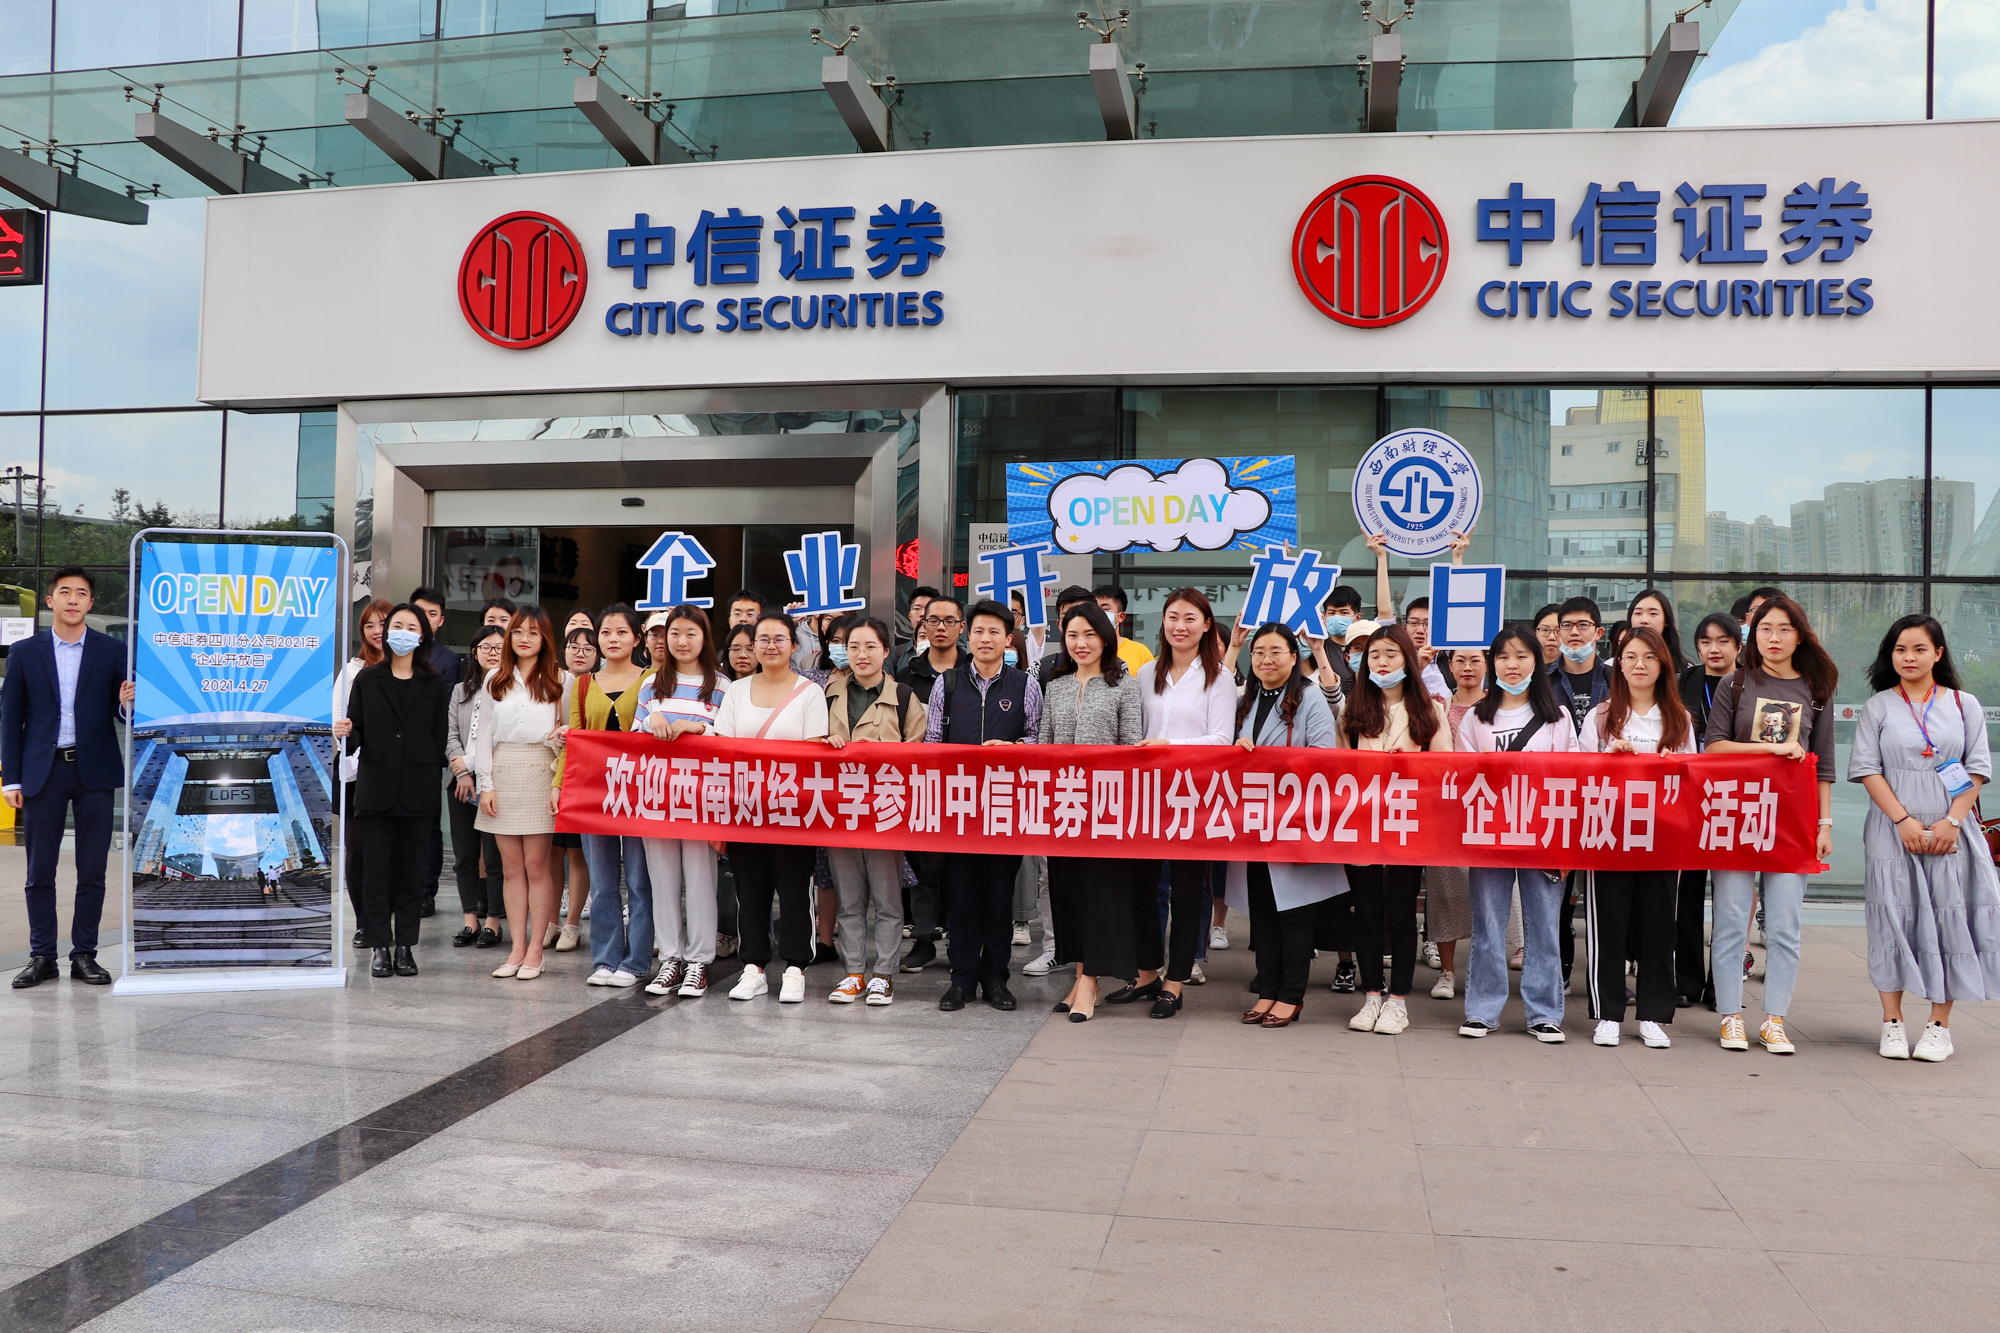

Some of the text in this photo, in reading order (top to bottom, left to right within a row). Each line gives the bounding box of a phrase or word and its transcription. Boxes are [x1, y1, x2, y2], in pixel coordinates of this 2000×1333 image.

[607, 199, 945, 289] 中信证券
[1477, 178, 1873, 266] 中信证券
[606, 291, 945, 336] CITIC SECURITIES
[1477, 278, 1874, 317] CITIC SECURITIES
[1068, 493, 1230, 527] OPEN DAY
[1366, 484, 1383, 529] SOUTHWESTERN
[1382, 528, 1416, 545] UNIVERSITY
[1426, 528, 1450, 544] FINANCE
[1455, 486, 1468, 519] ECONOMICS
[151, 572, 247, 615] OPEN
[251, 575, 329, 618] DAY
[638, 534, 712, 608] 企
[786, 534, 862, 614] 业
[978, 545, 1057, 625] 开
[1242, 548, 1338, 636] 放
[1432, 566, 1502, 647] 日
[153, 632, 320, 650] 中信证券四川分公司2021年
[201, 679, 269, 693] 2021.4.27
[210, 789, 251, 801] LDFS
